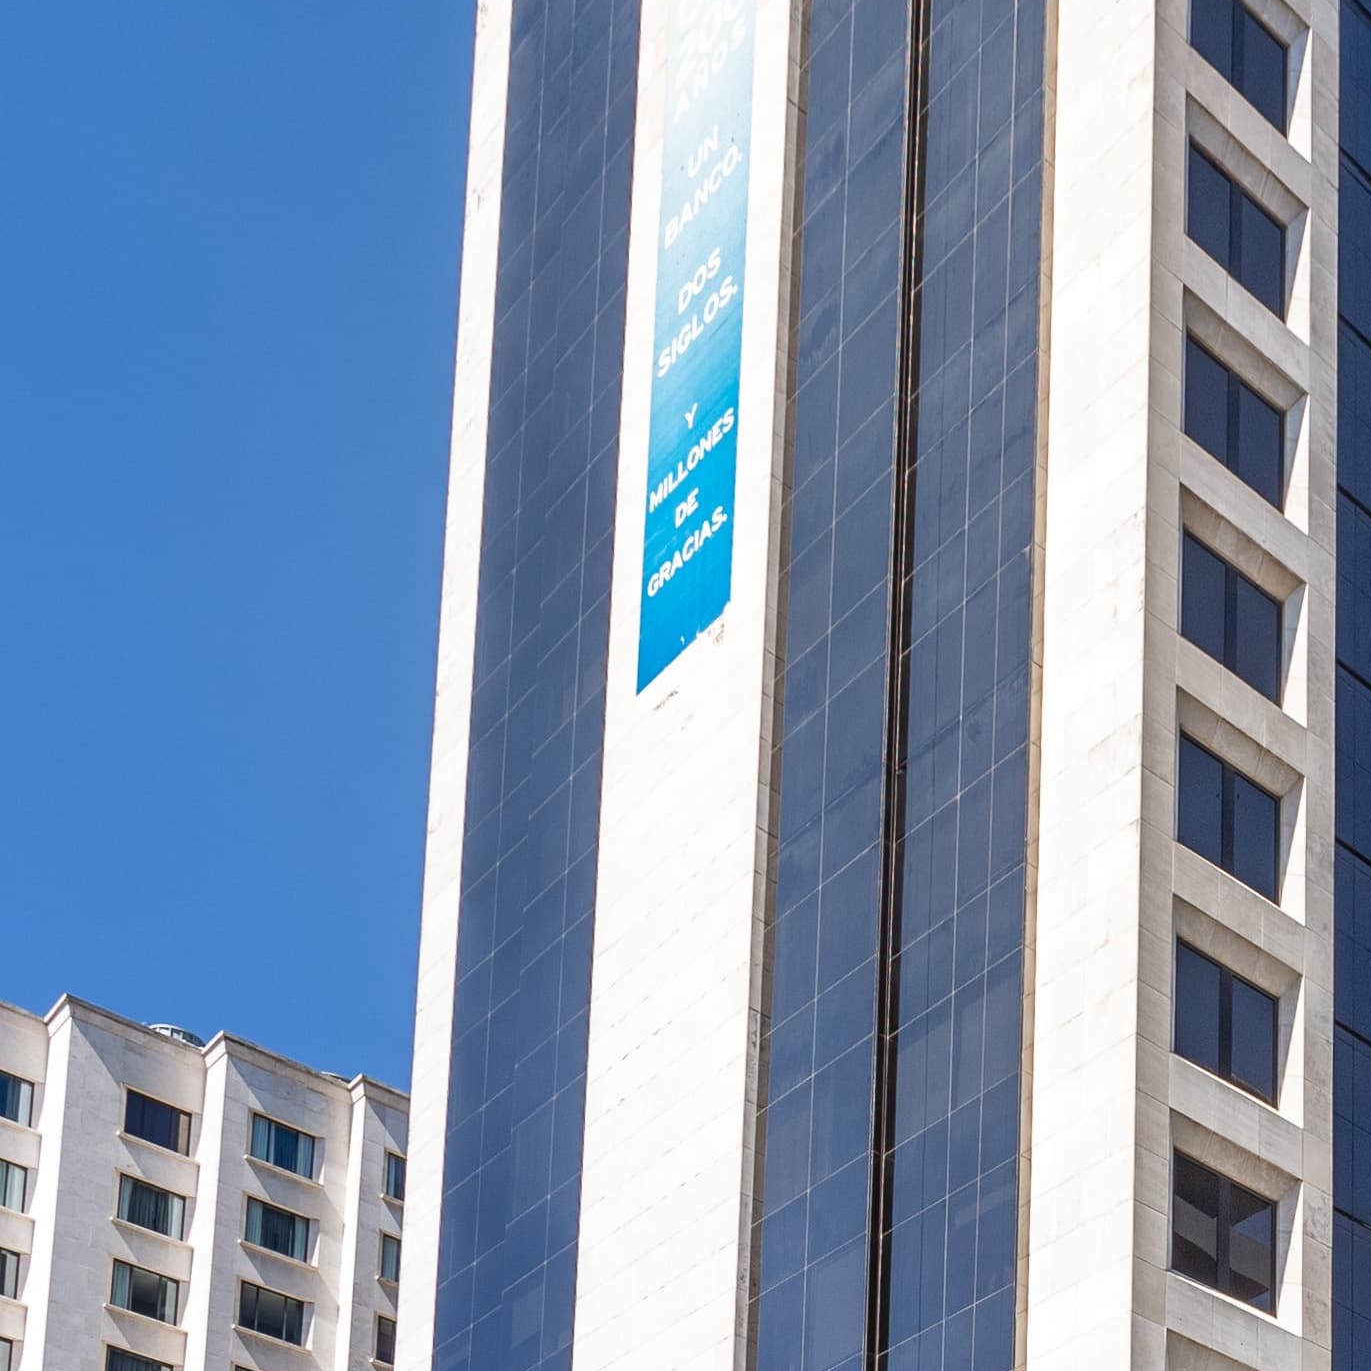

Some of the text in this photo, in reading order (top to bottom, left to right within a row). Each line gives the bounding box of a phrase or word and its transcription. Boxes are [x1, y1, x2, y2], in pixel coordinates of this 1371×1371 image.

[687, 125, 719, 178] UN
[664, 144, 743, 249] BANCO.
[678, 247, 721, 316] DOS
[657, 275, 738, 378] SIGLOS.
[684, 403, 698, 430] Y
[649, 408, 735, 513] MILLONES
[674, 487, 699, 529] DE
[647, 506, 728, 597] GRACIAS.
